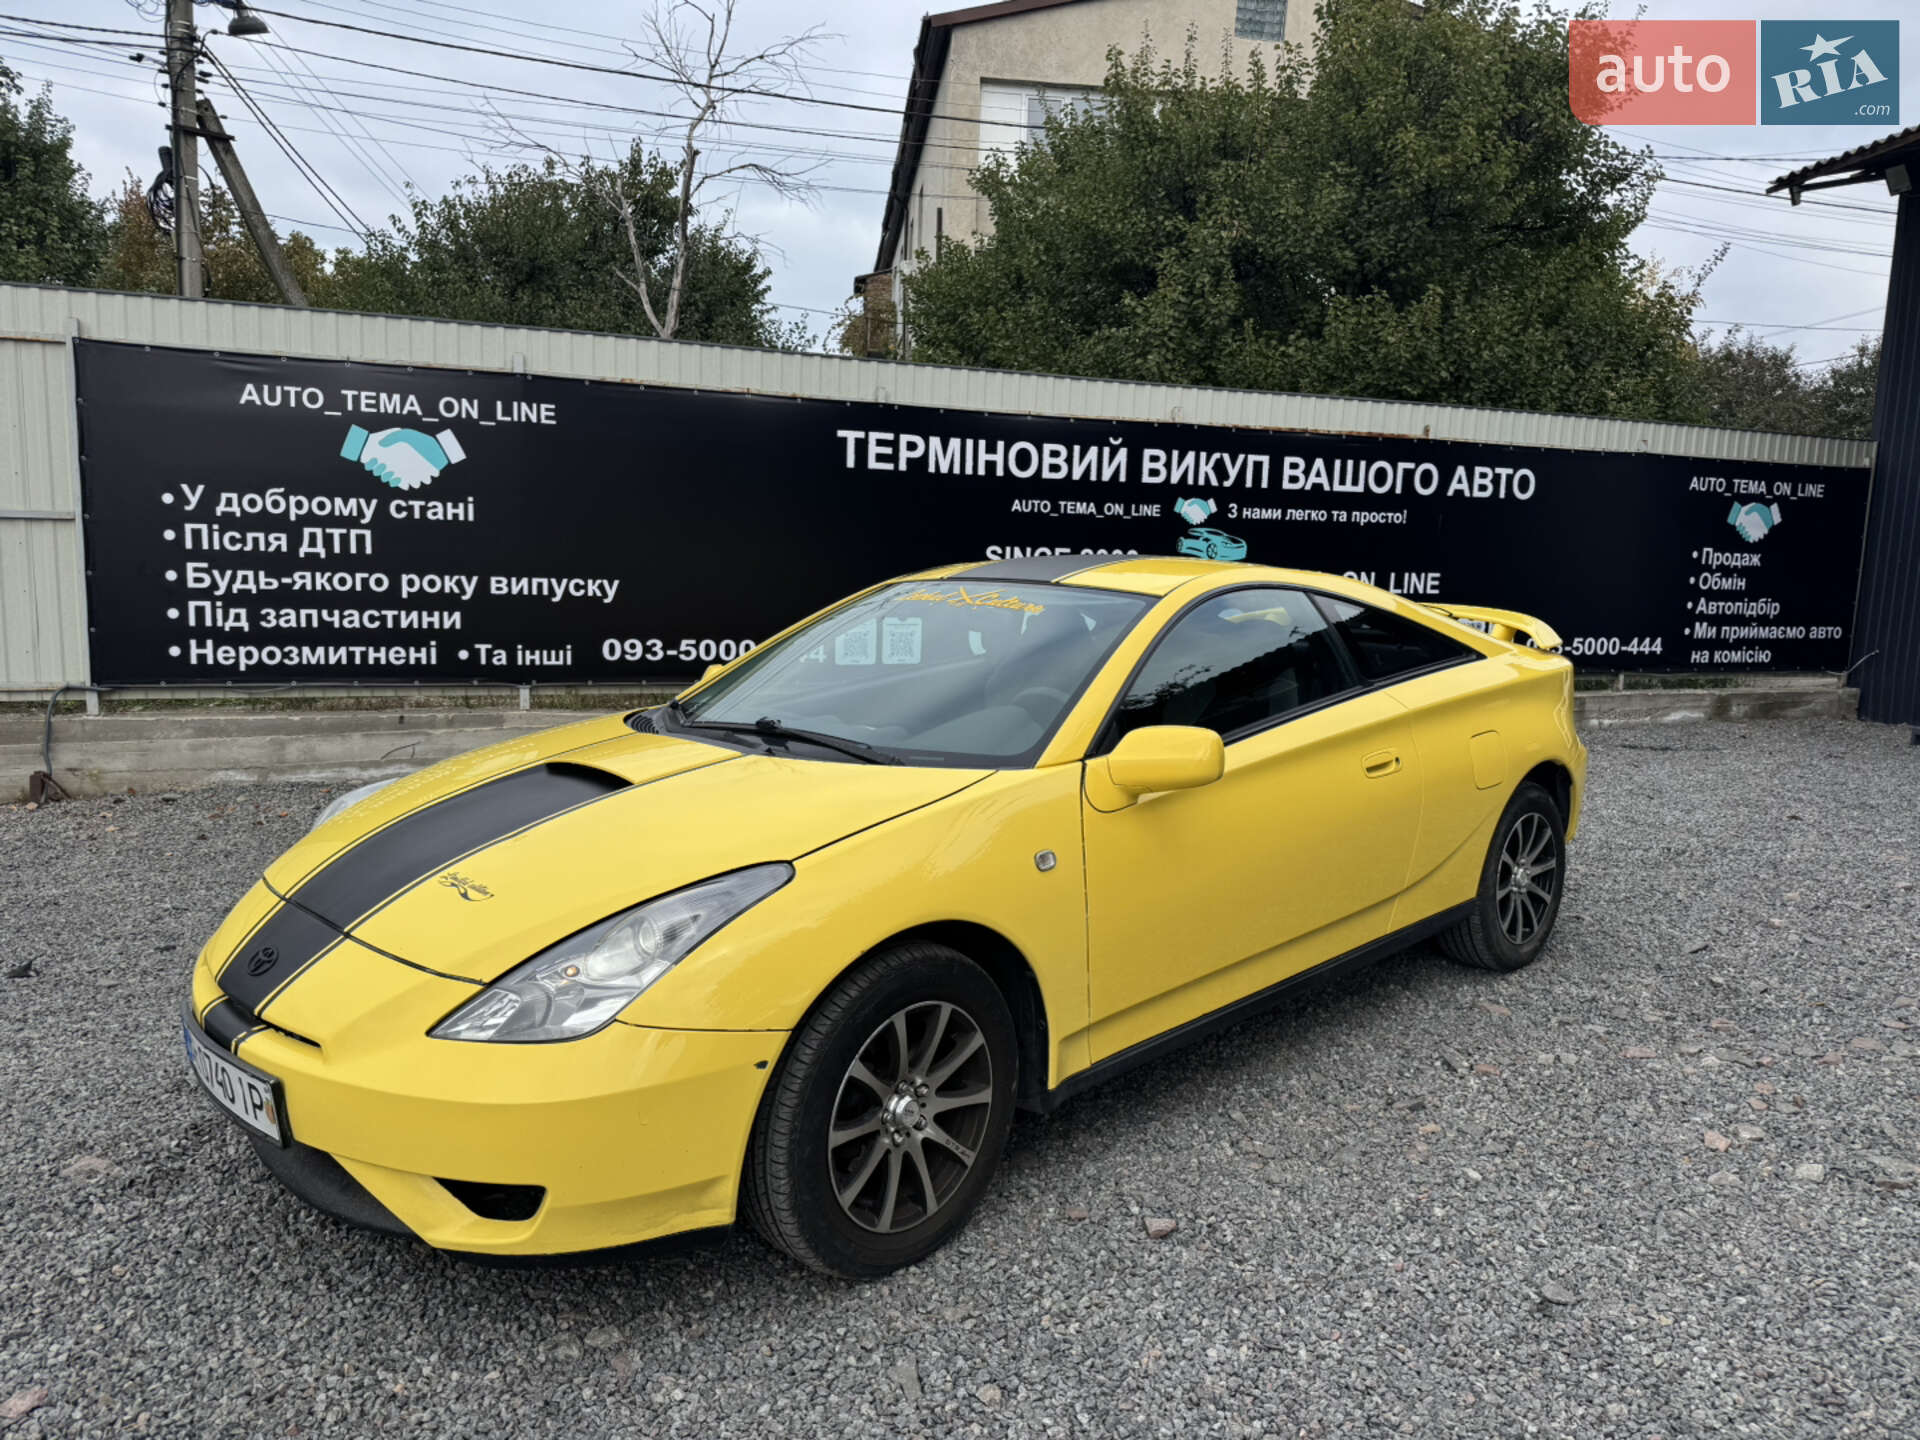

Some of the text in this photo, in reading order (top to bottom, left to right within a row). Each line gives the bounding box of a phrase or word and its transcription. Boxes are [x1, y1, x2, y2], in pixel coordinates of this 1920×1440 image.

[239, 383, 557, 425] AUTO_TEMA_ON_LINE
[836, 429, 1536, 500] ТЕРМІНОВИЙ ВИКУП ВАШОГО АВТО
[1689, 476, 1825, 498] AUTO_TEMA_ON_LINE
[180, 483, 474, 525] У доброму стані
[1011, 499, 1161, 518] AUTO_TEMA_ON_LINE
[1242, 507, 1282, 520] нами
[1286, 508, 1328, 521] легко
[1331, 510, 1347, 522] та
[1351, 509, 1407, 526] просто!
[183, 523, 372, 558] Після ДТП
[1702, 547, 1761, 569] Продаж
[186, 562, 620, 604] Будь-якого року випуску
[1699, 572, 1746, 591] Обмін
[188, 600, 462, 633] Під запчастини
[1695, 597, 1780, 618] Автопідбір
[1694, 622, 1842, 642] Ми приймаємо авто
[189, 639, 437, 672] Нерозмитнені
[475, 643, 572, 666] Та інші
[1690, 646, 1772, 663] на комісію
